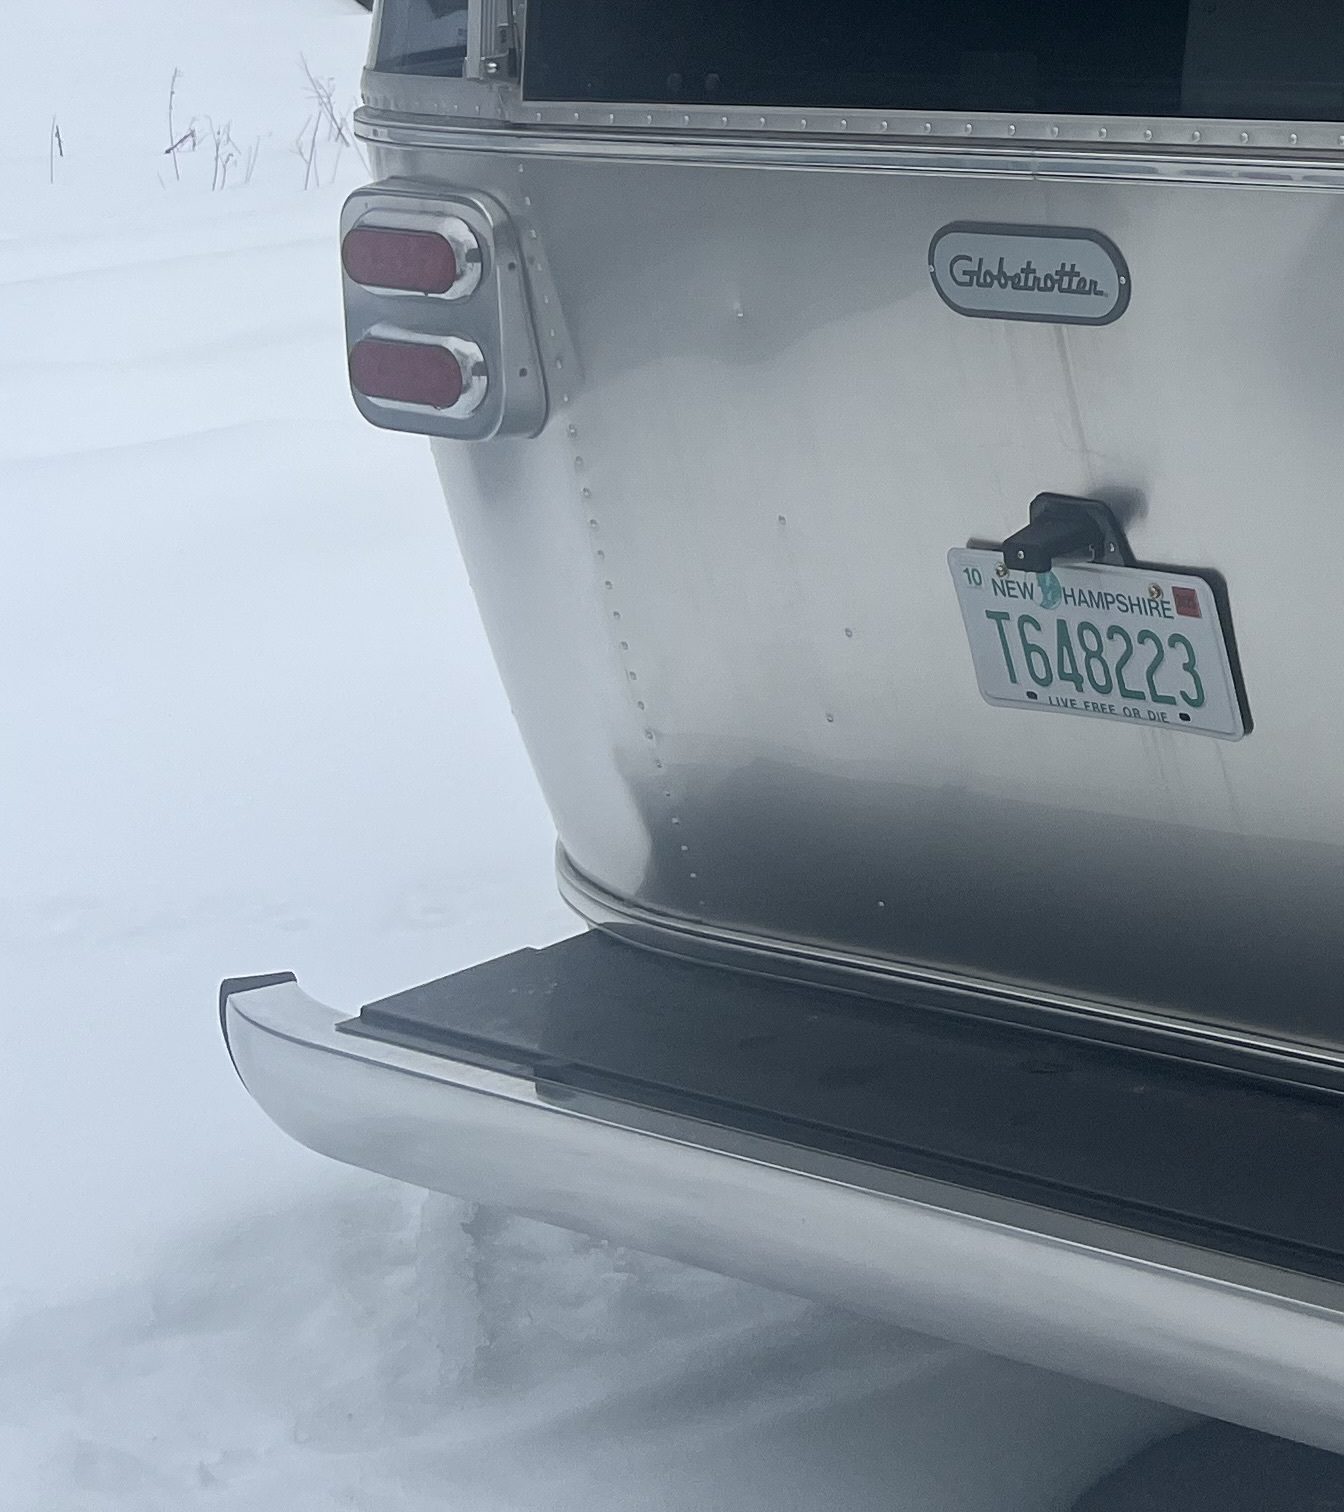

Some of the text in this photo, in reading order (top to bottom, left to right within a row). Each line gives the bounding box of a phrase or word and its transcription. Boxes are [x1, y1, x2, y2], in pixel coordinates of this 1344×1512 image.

[949, 254, 1108, 297] Globetrotter
[962, 567, 983, 586] 10
[991, 578, 1034, 600] NEW
[1062, 588, 1175, 619] HAMPSHIRE
[985, 609, 1205, 708] T648223
[1049, 696, 1170, 723] LIVE FREE OR DIE
